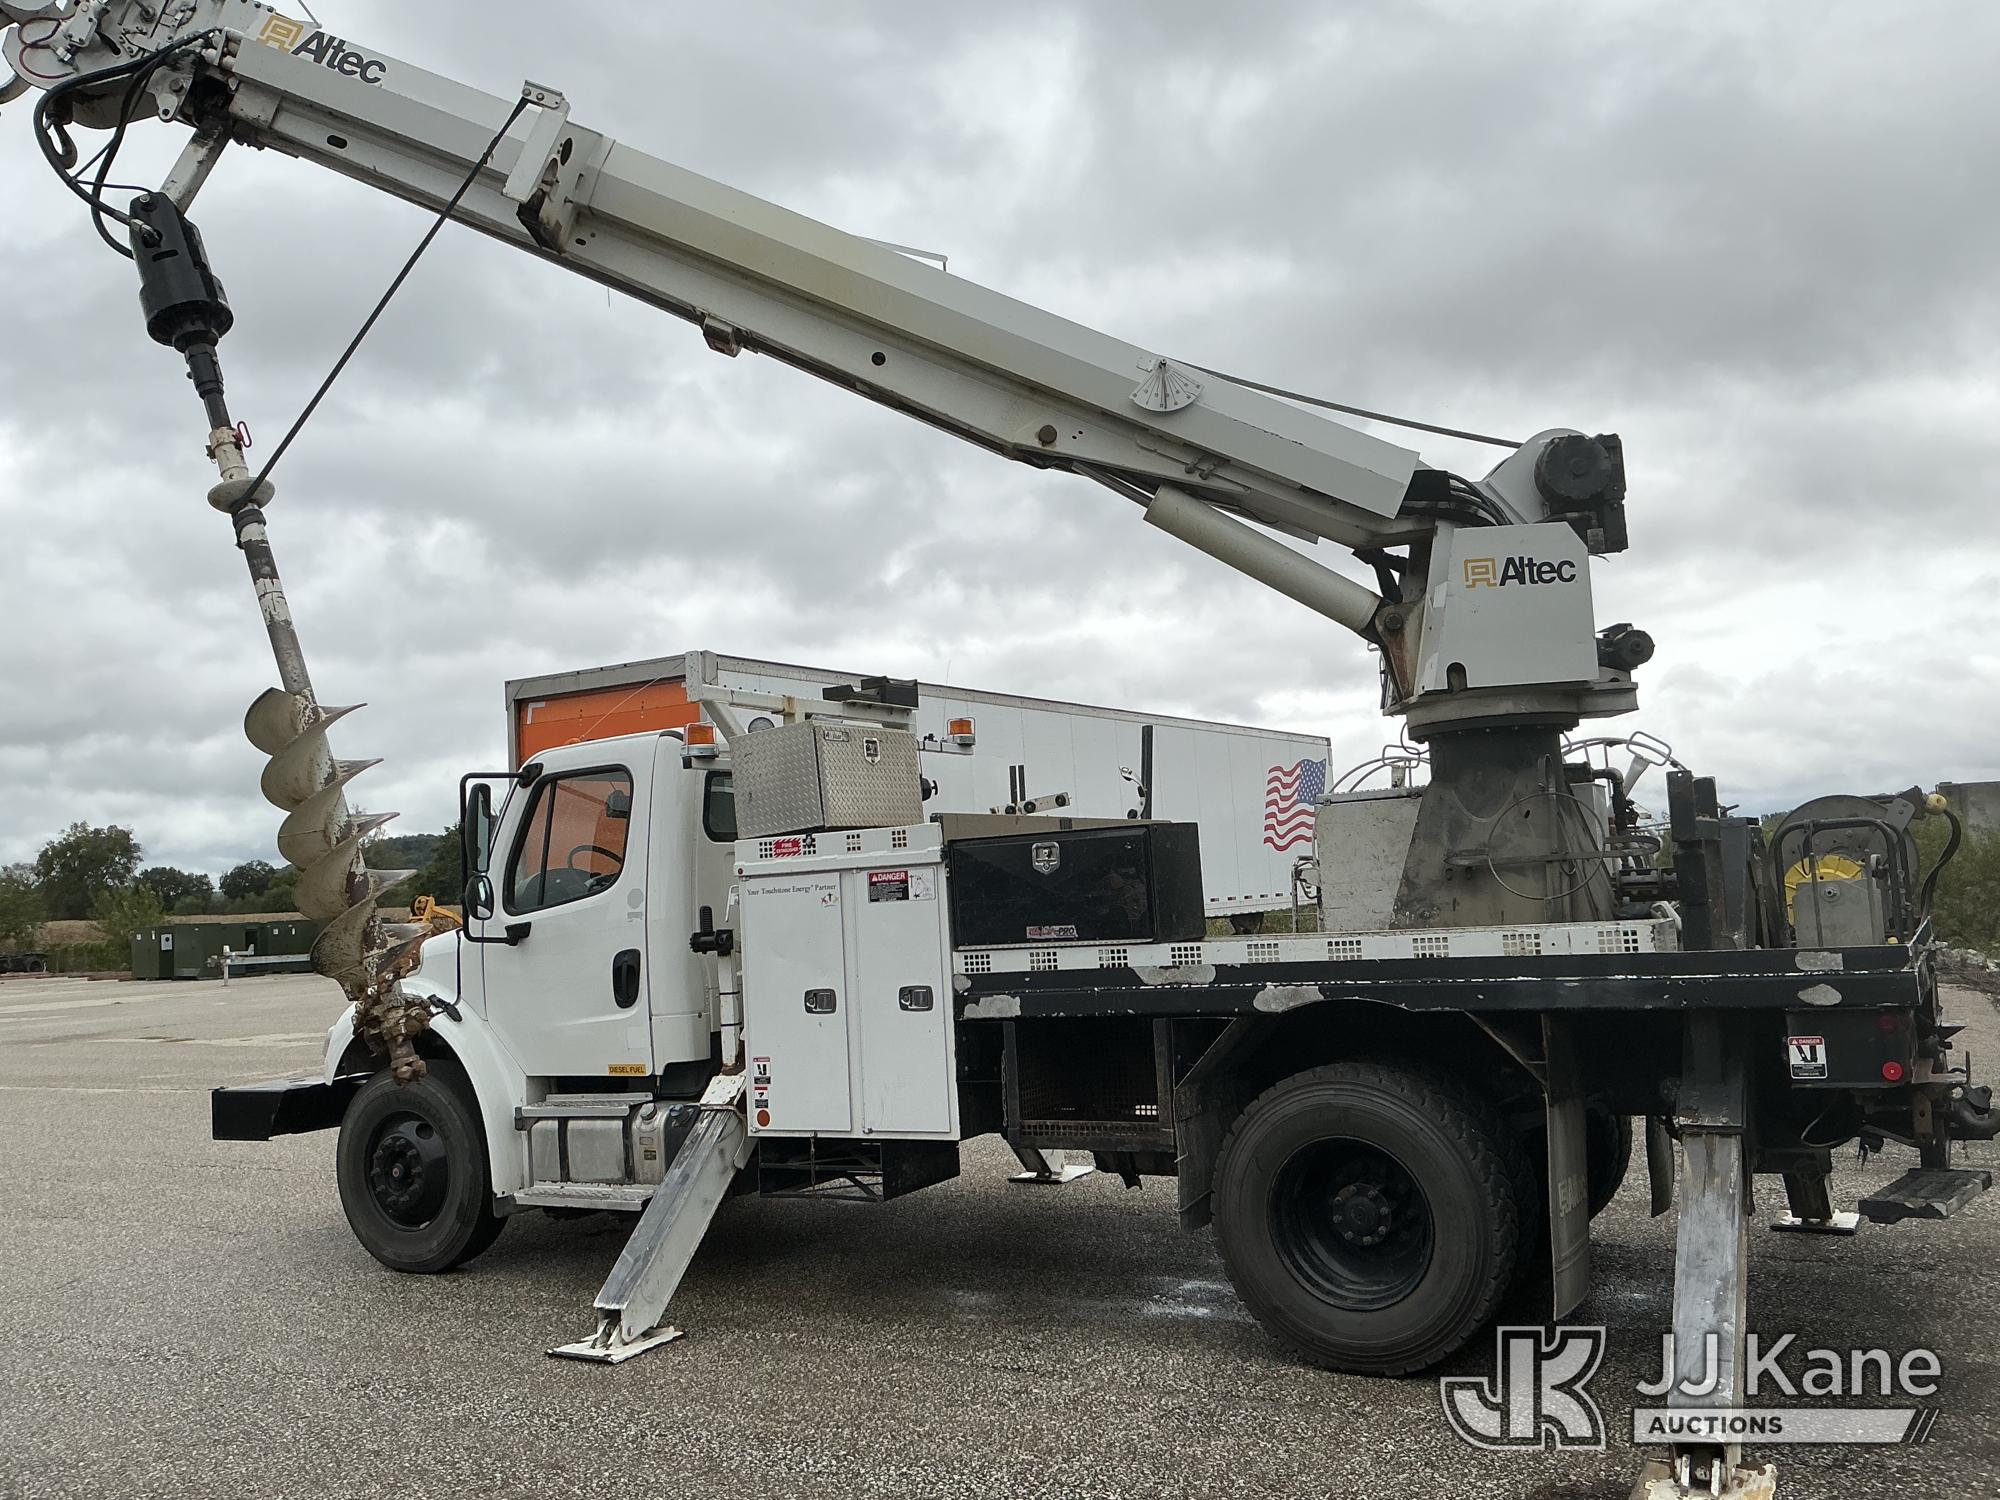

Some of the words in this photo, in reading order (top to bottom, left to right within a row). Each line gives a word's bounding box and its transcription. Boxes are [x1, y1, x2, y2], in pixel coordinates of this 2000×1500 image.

[291, 30, 387, 84] Altec
[1499, 556, 1577, 587] Altec
[877, 871, 906, 881] DANGER
[747, 888, 759, 896] Your
[761, 887, 791, 895] Touchstone
[630, 1066, 644, 1074] FUEL
